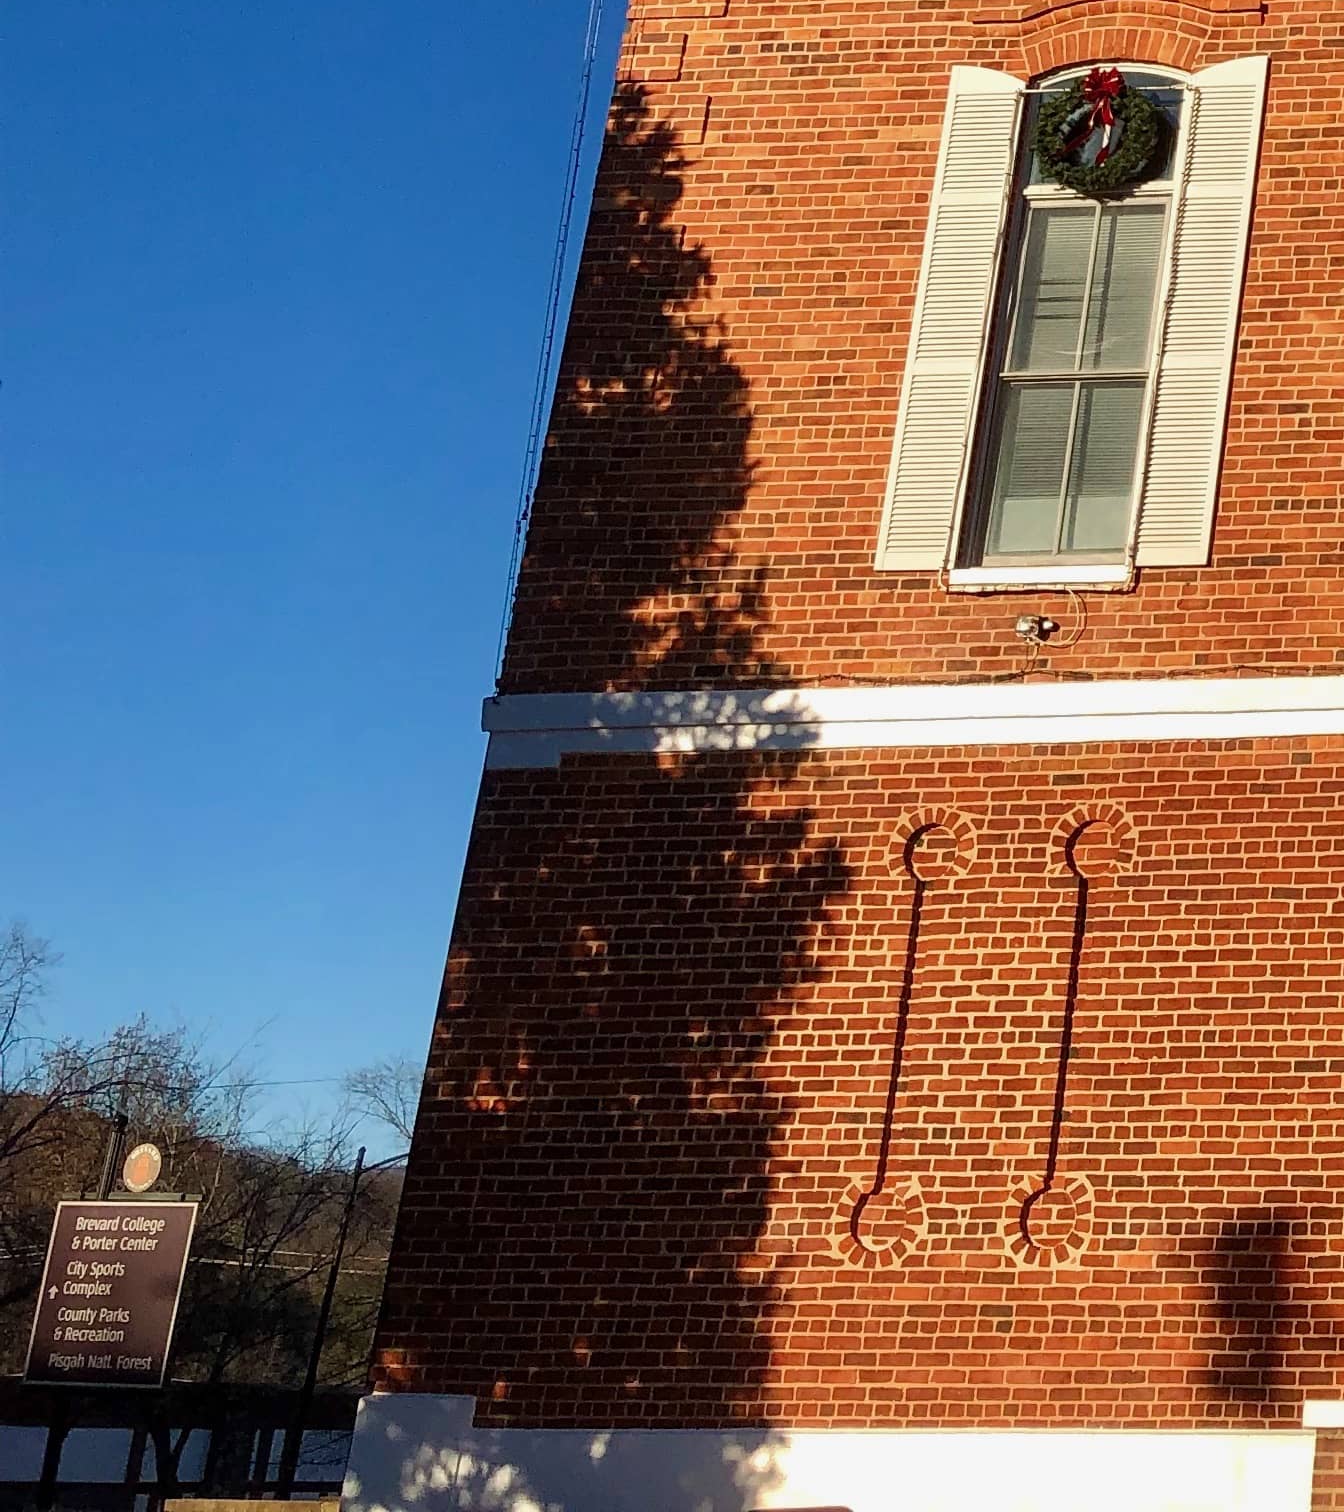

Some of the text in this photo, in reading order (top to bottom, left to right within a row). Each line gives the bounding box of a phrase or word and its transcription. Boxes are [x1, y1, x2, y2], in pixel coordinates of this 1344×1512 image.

[75, 1216, 165, 1235] Brevard College
[71, 1236, 159, 1251] & Porter Center
[66, 1260, 126, 1279] City Sports
[63, 1280, 112, 1299] Complex
[57, 1306, 131, 1326] County Parks
[53, 1326, 125, 1343] & Recreation
[48, 1352, 85, 1371] Pisgah
[116, 1355, 152, 1370] Forest
